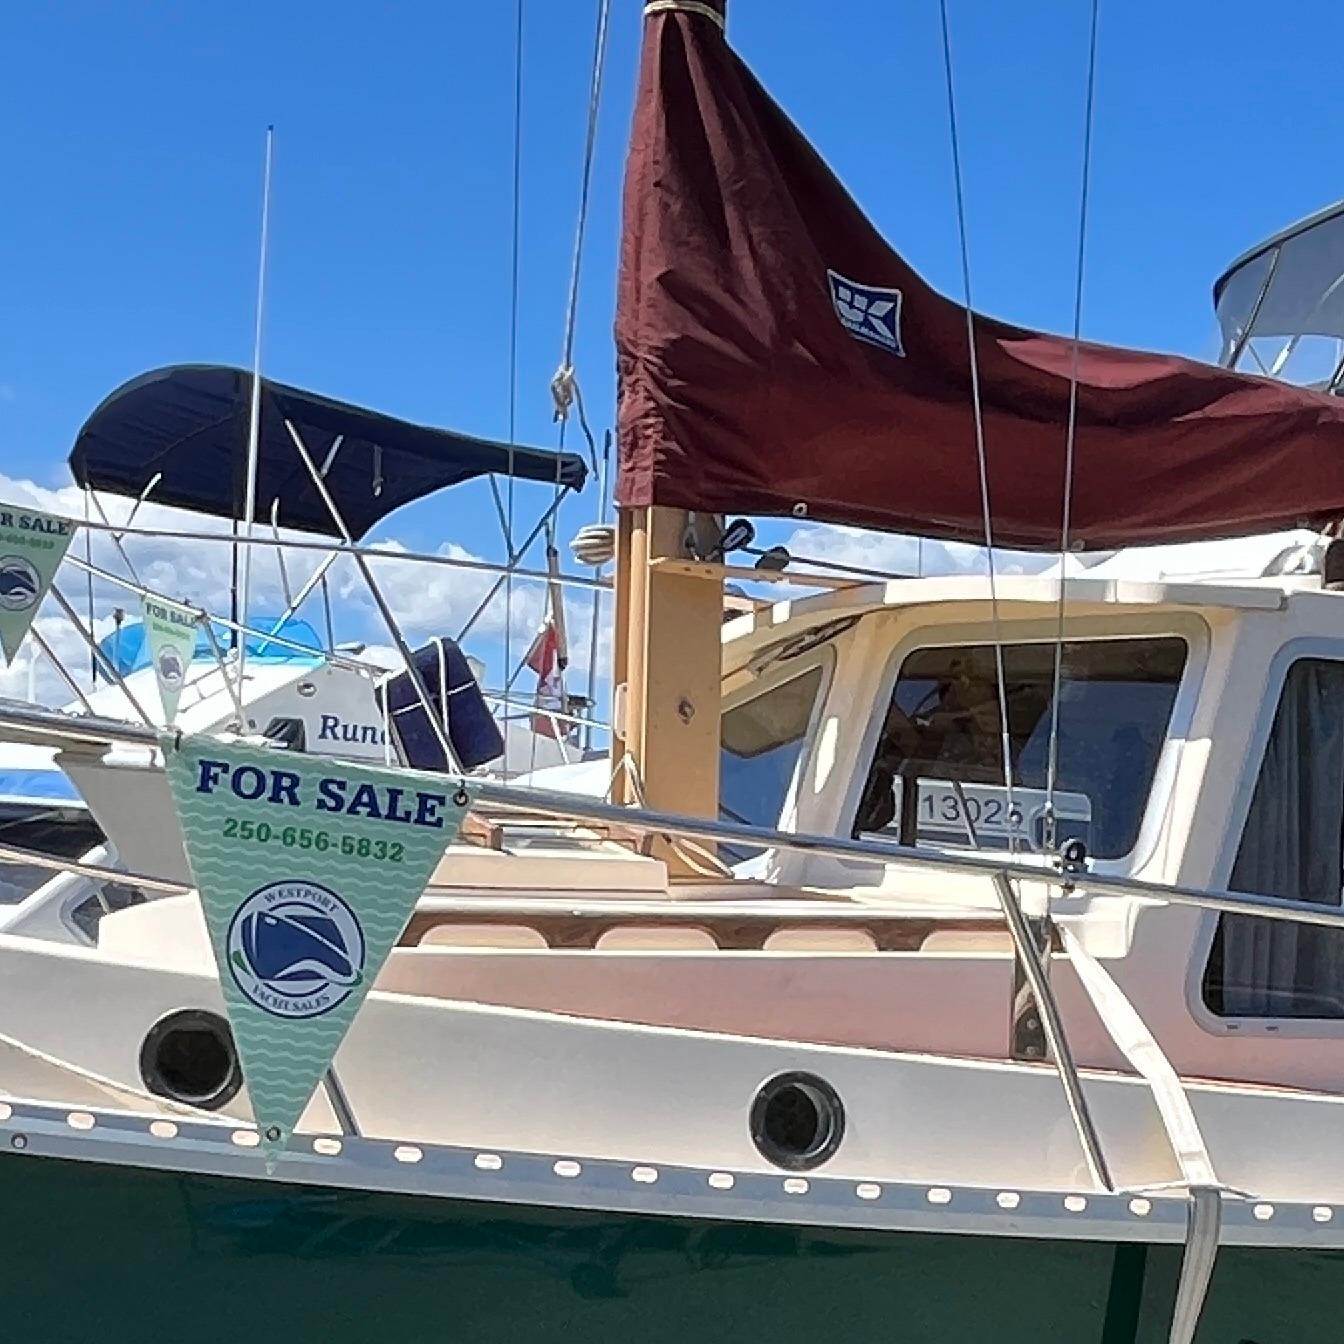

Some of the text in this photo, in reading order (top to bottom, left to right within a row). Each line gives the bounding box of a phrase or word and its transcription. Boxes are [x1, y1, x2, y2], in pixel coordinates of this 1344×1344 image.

[18, 515, 69, 536] SALE
[145, 602, 168, 621] FOR
[195, 758, 447, 828] FOR SALE
[222, 816, 405, 863] 250-656-5832
[264, 888, 340, 912] WESTPORT
[252, 984, 330, 1011] YACHT SALES
